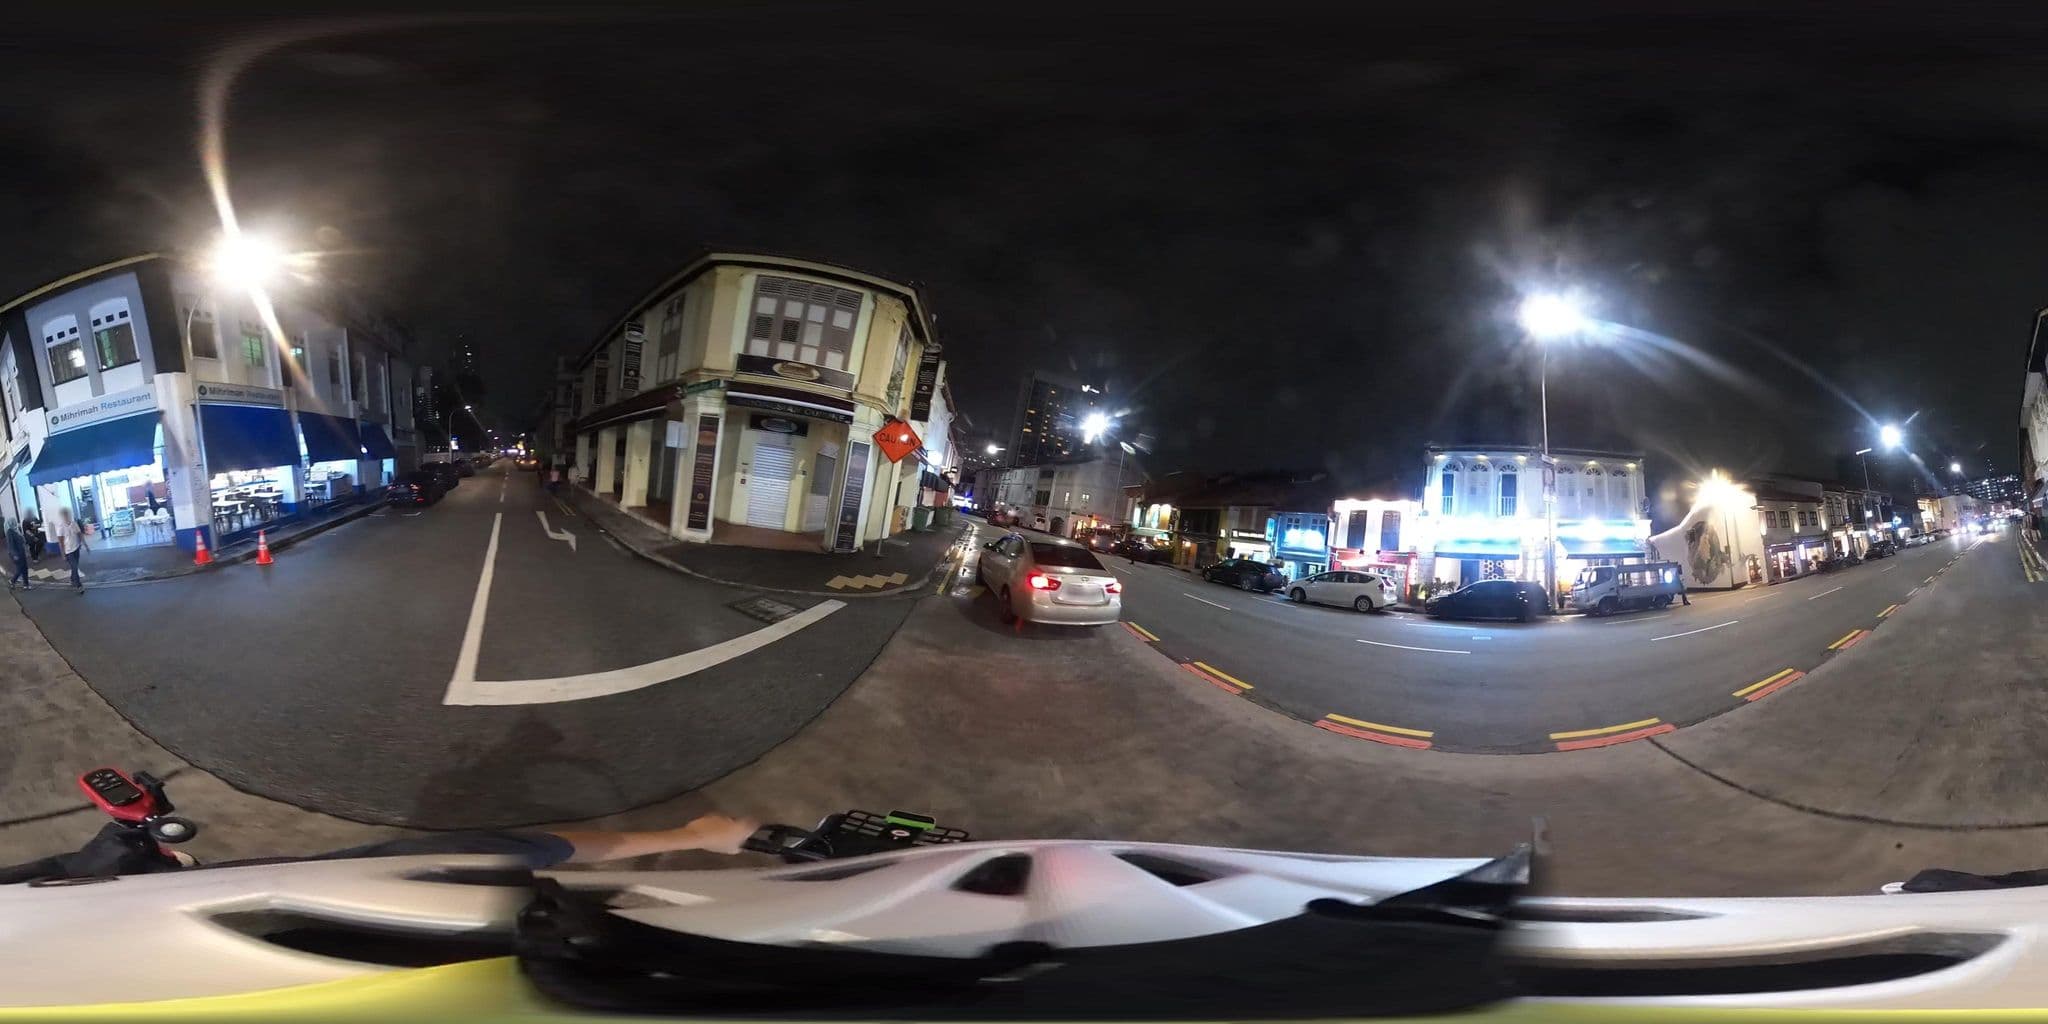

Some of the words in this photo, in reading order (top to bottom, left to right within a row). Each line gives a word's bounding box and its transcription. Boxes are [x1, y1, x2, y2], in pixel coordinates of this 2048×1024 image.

[60, 405, 99, 421] Mihrimah
[100, 392, 151, 410] Restaurant
[741, 398, 800, 414] DOESIA
[804, 407, 846, 421] CUNE
[878, 432, 917, 447] CAUON
